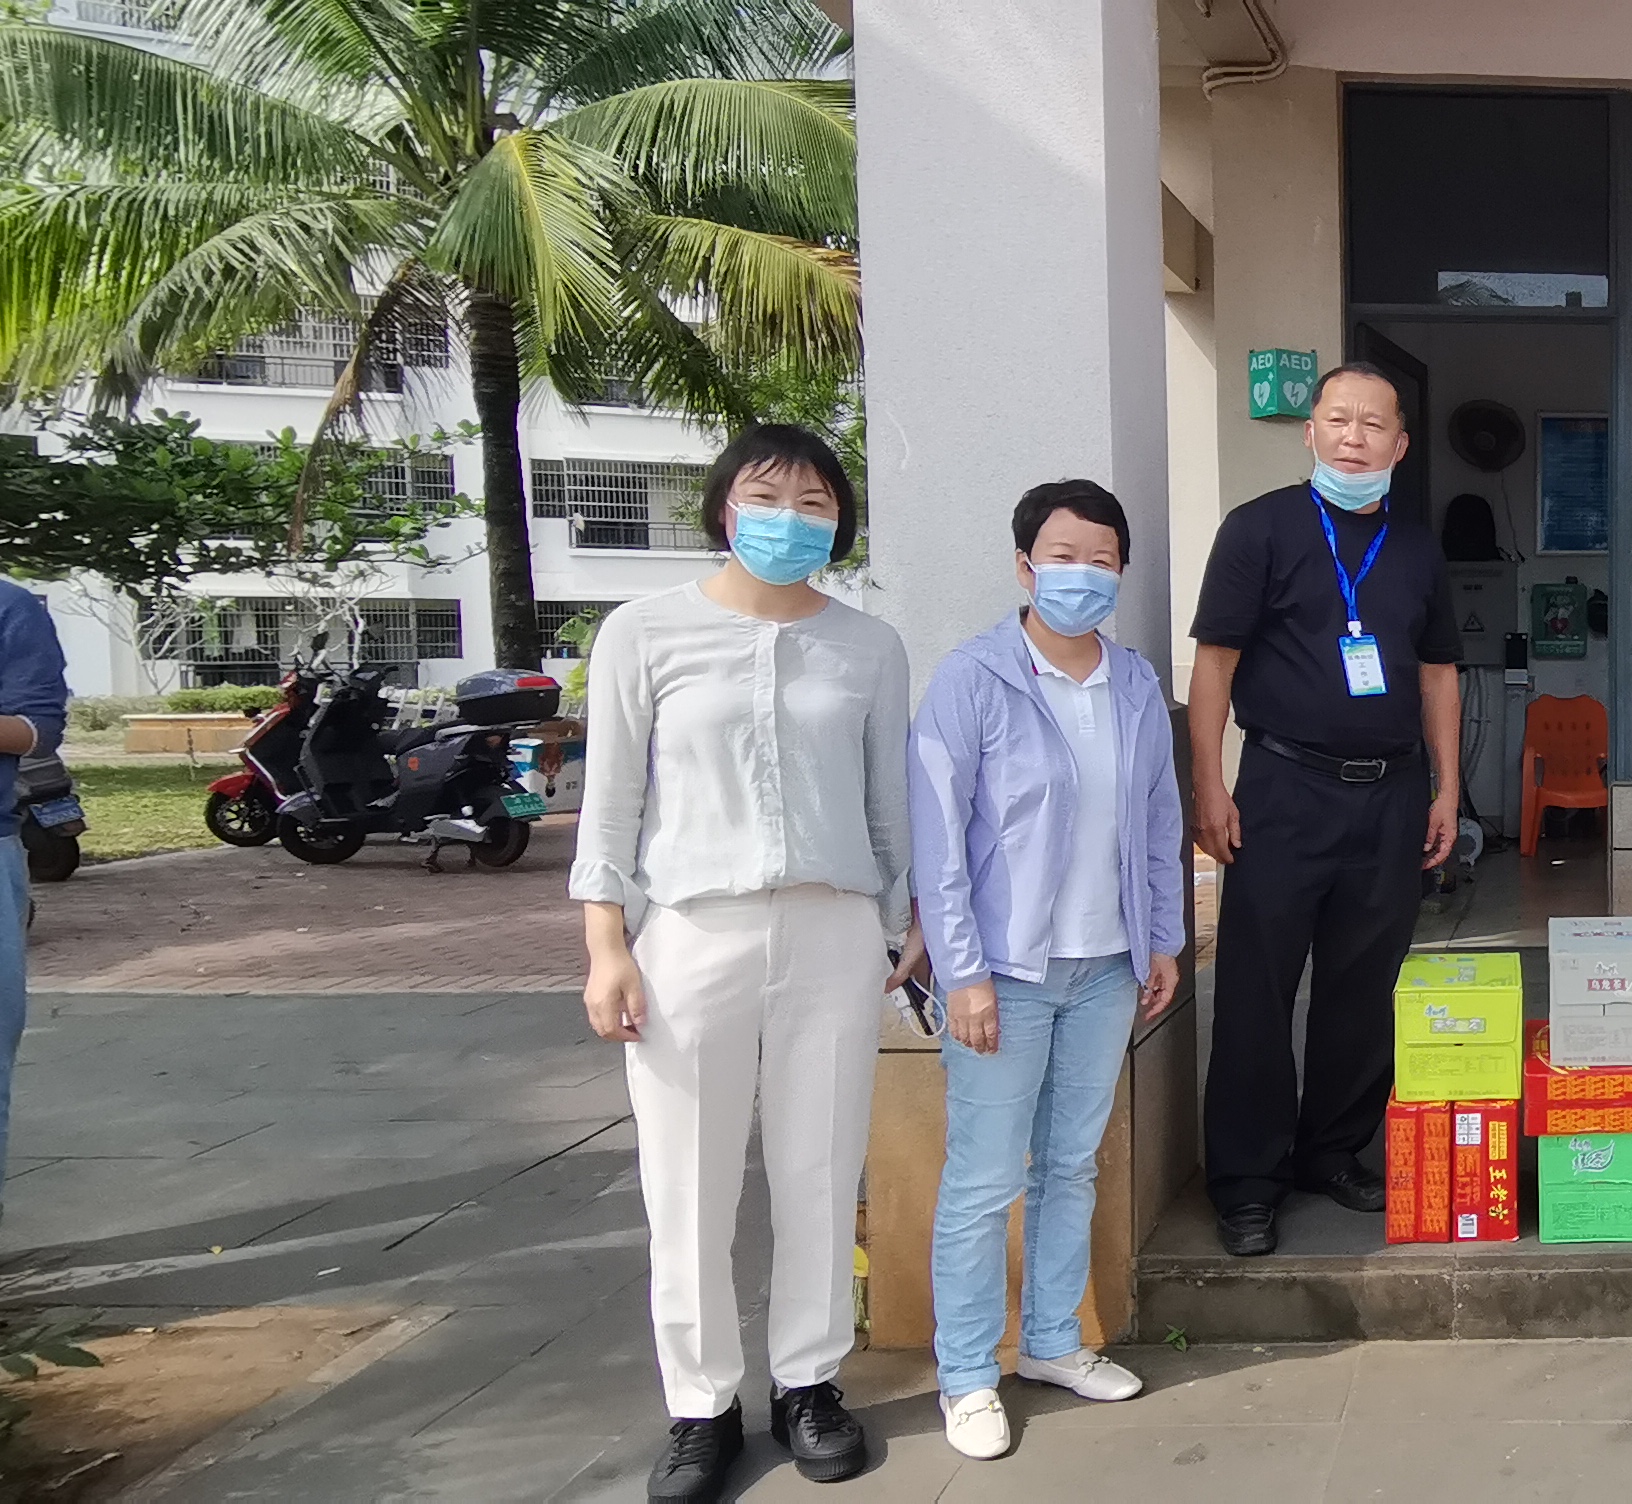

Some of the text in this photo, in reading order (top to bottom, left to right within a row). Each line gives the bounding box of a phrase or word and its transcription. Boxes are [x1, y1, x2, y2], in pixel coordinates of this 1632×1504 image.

[1250, 353, 1273, 371] AED
[1280, 353, 1312, 371] AED
[1591, 979, 1622, 991] 乌龙茶
[1489, 1166, 1509, 1220] 王老吉
